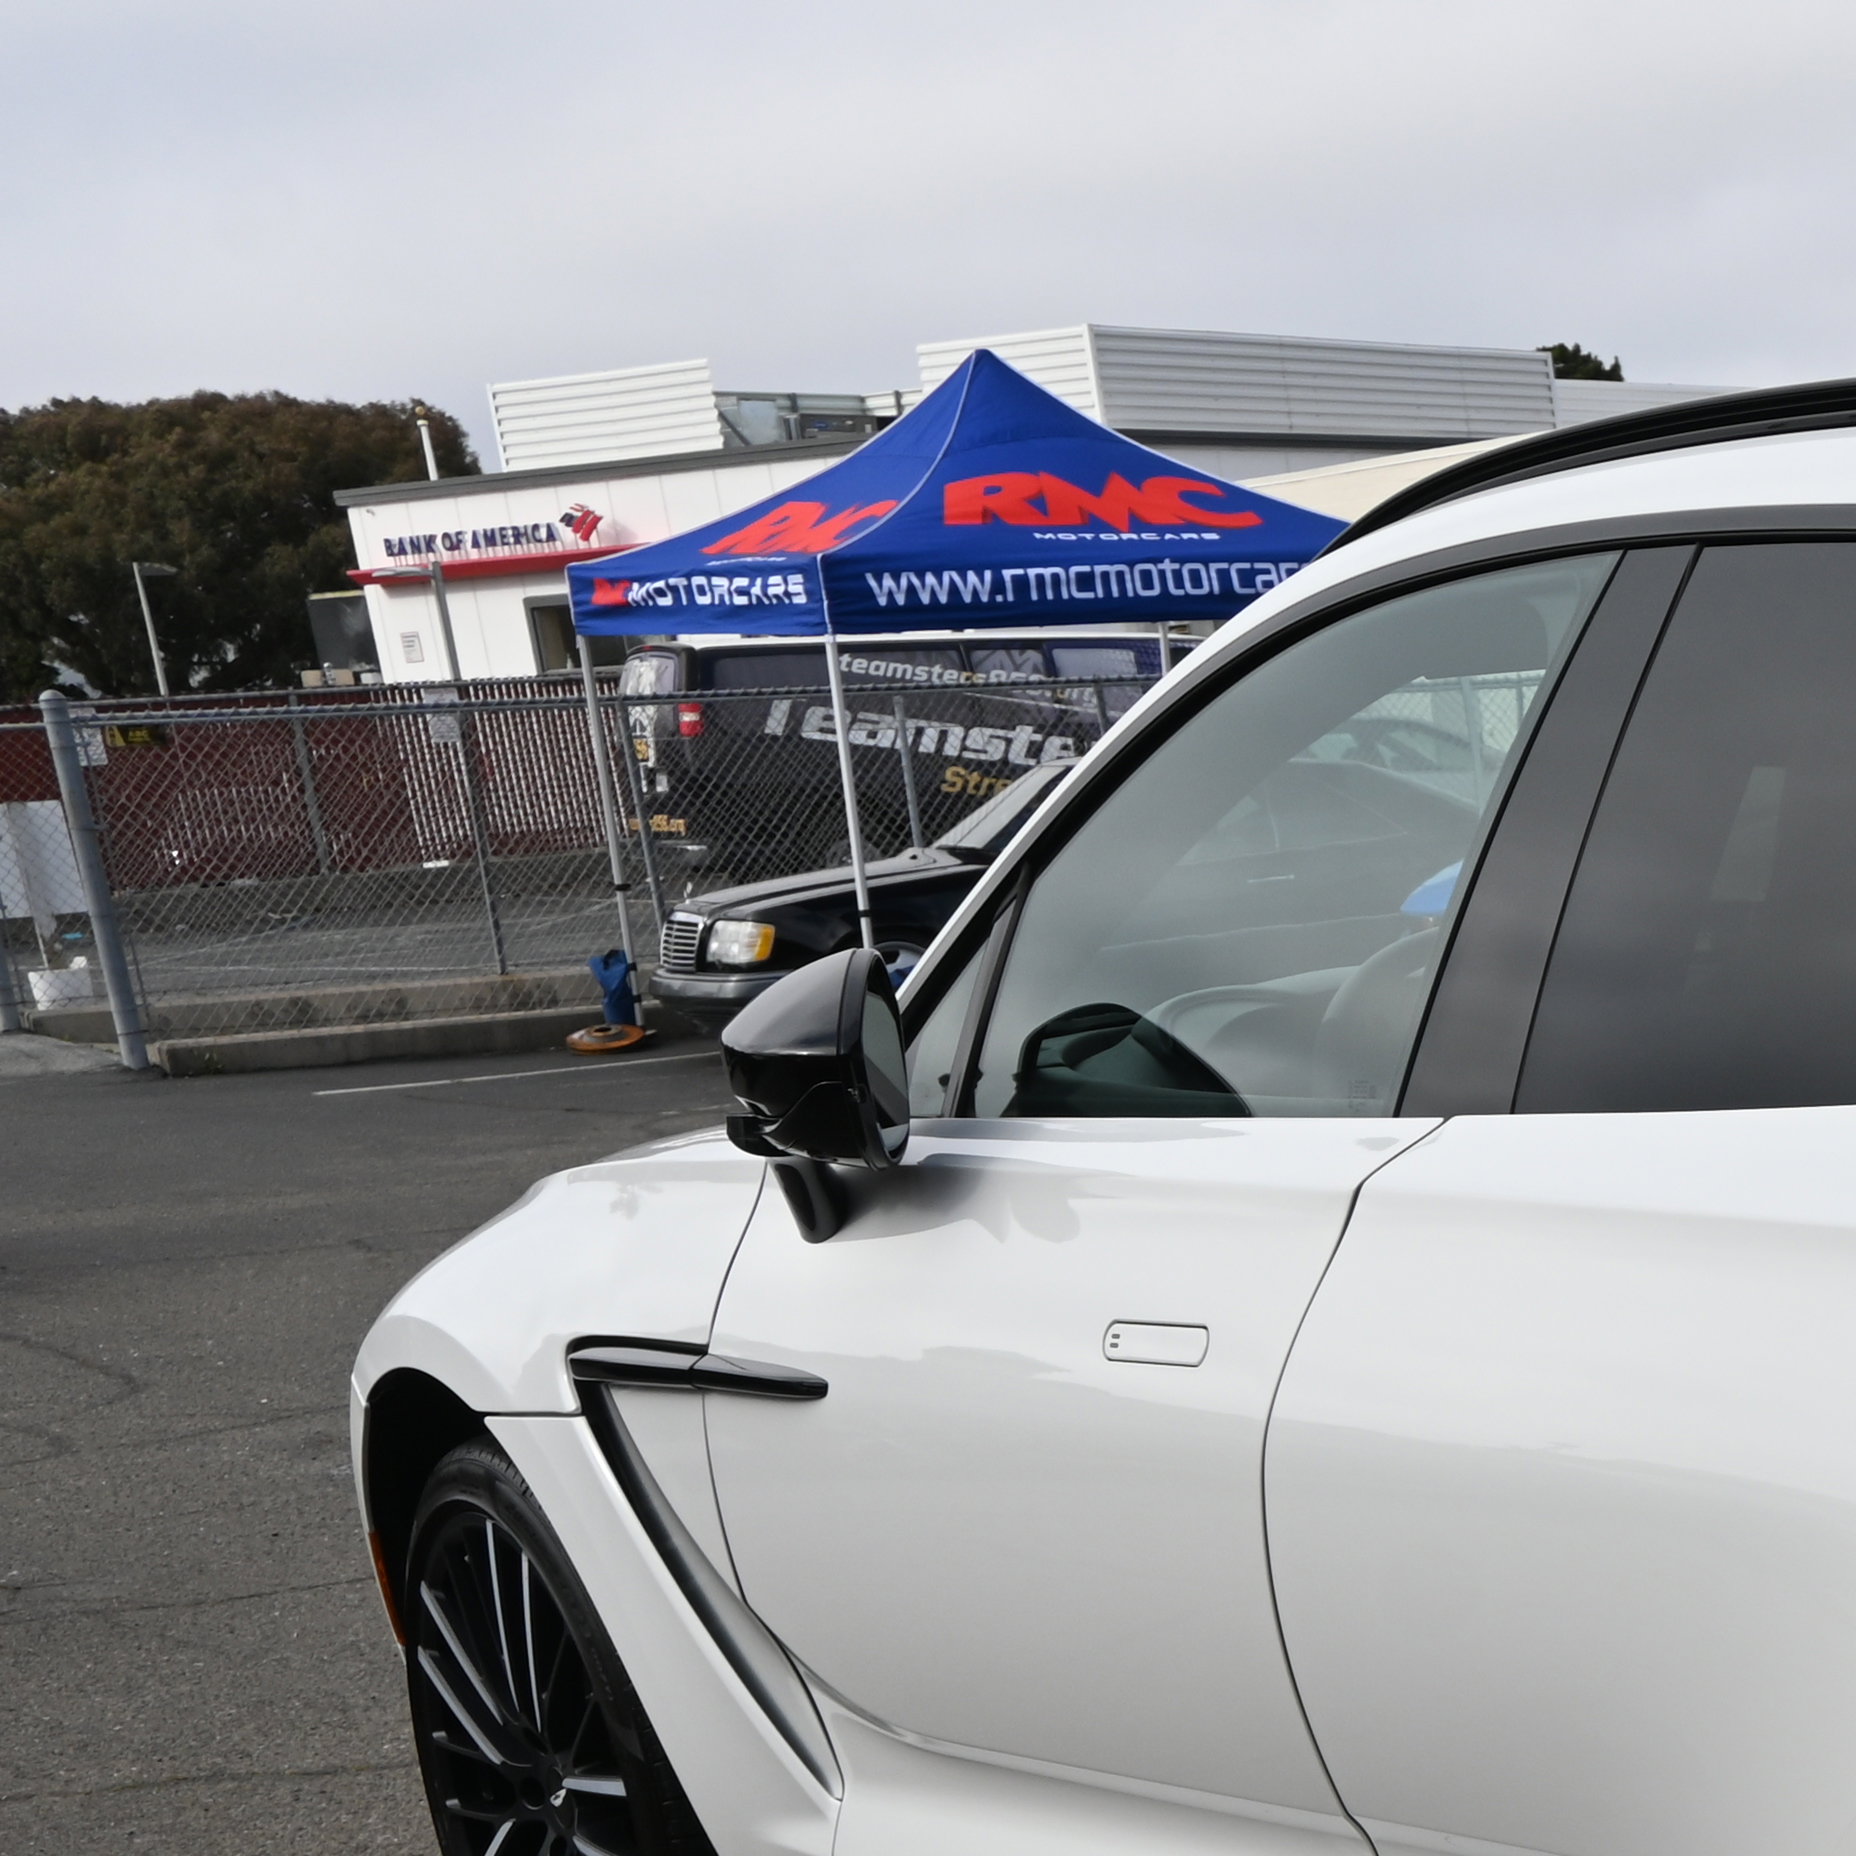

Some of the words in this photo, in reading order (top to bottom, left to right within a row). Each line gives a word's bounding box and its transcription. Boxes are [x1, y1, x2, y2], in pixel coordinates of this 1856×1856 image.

[944, 471, 1263, 532] RMC
[383, 533, 437, 557] BANK
[441, 530, 466, 552] OF
[471, 522, 560, 550] AMERICA
[1033, 531, 1221, 541] MOTORCARS
[627, 573, 807, 606] MOTORCARS
[865, 557, 1310, 606] www.rmcmotorcar
